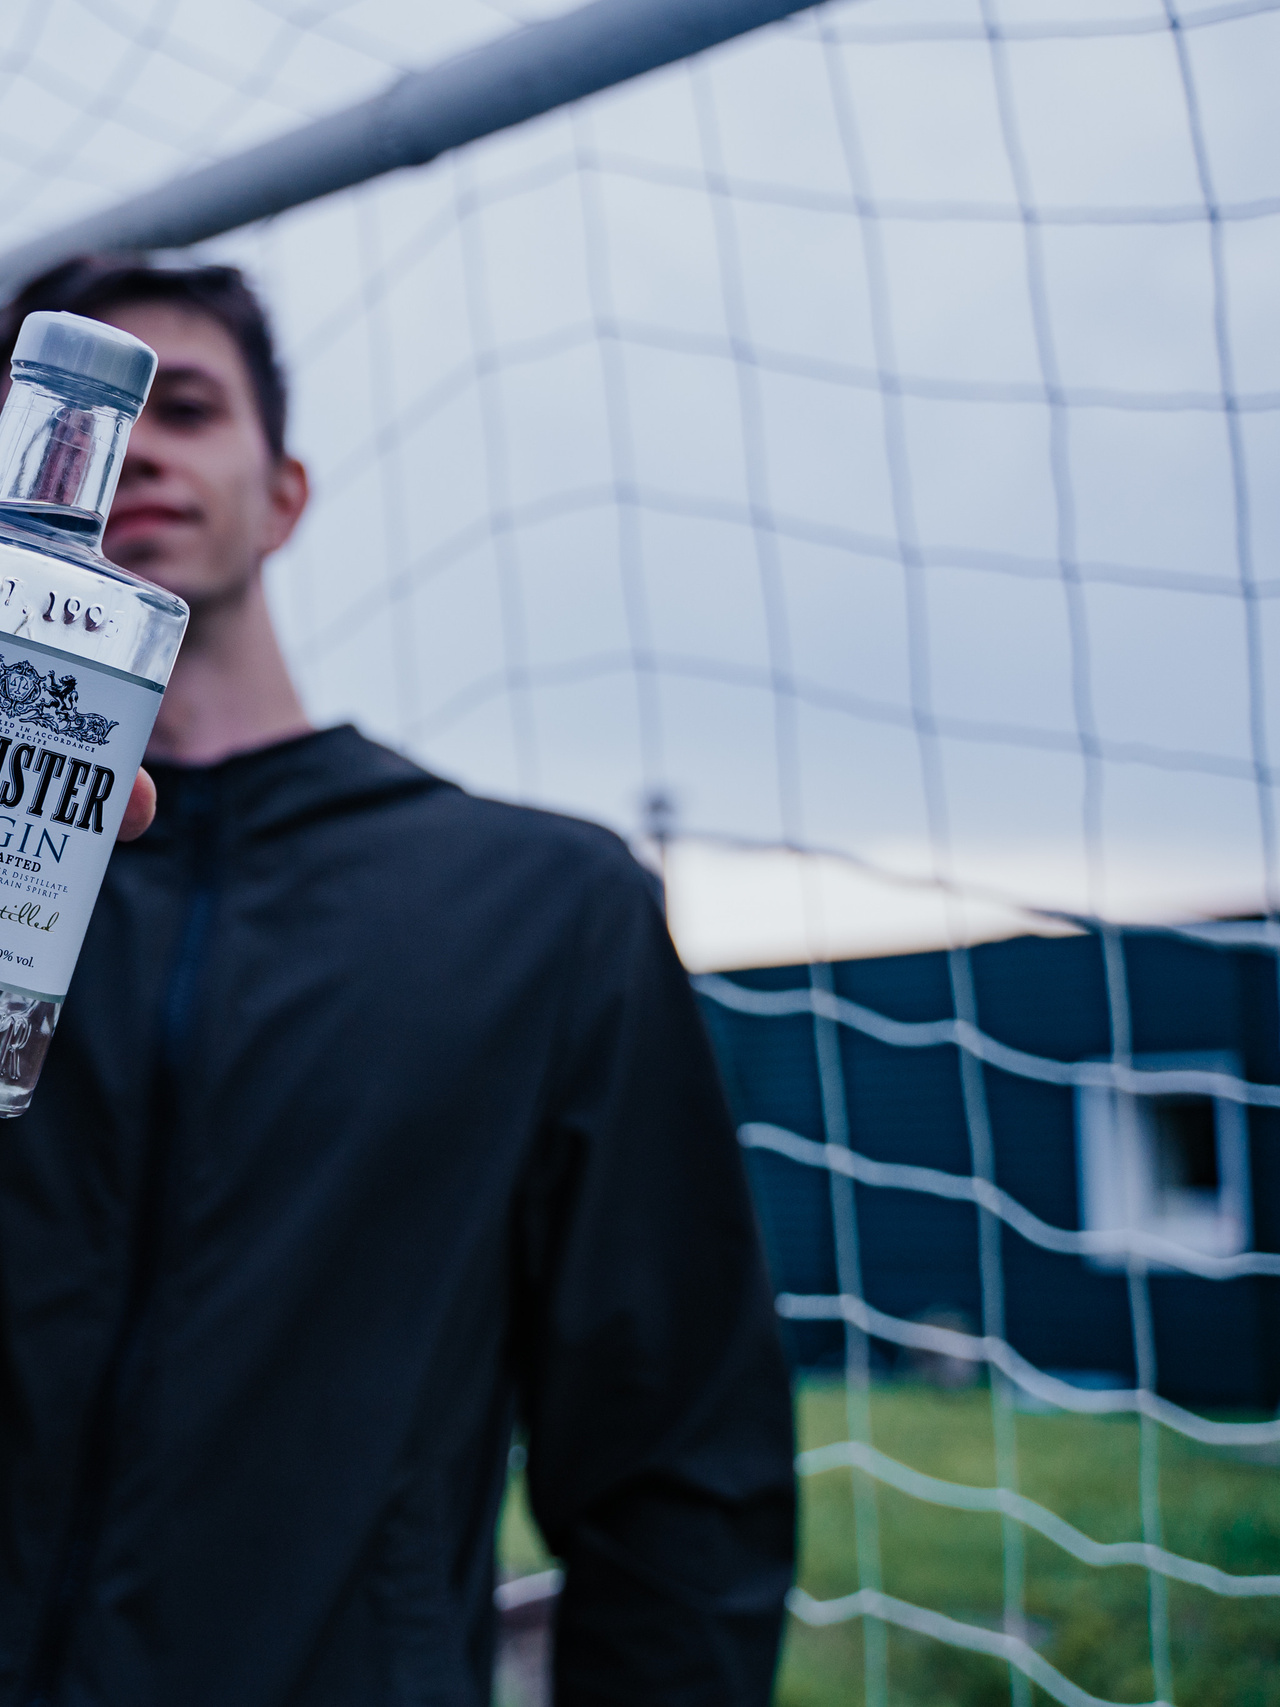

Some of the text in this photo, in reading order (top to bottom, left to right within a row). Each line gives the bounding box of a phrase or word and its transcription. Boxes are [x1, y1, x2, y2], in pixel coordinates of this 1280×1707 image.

[15, 732, 48, 746] RECIPE
[20, 725, 31, 734] IN
[35, 730, 96, 753] ACCORDANCE
[12, 871, 69, 893] DISTILLATE
[26, 885, 59, 900] SPIRIT
[16, 954, 35, 968] vol.
